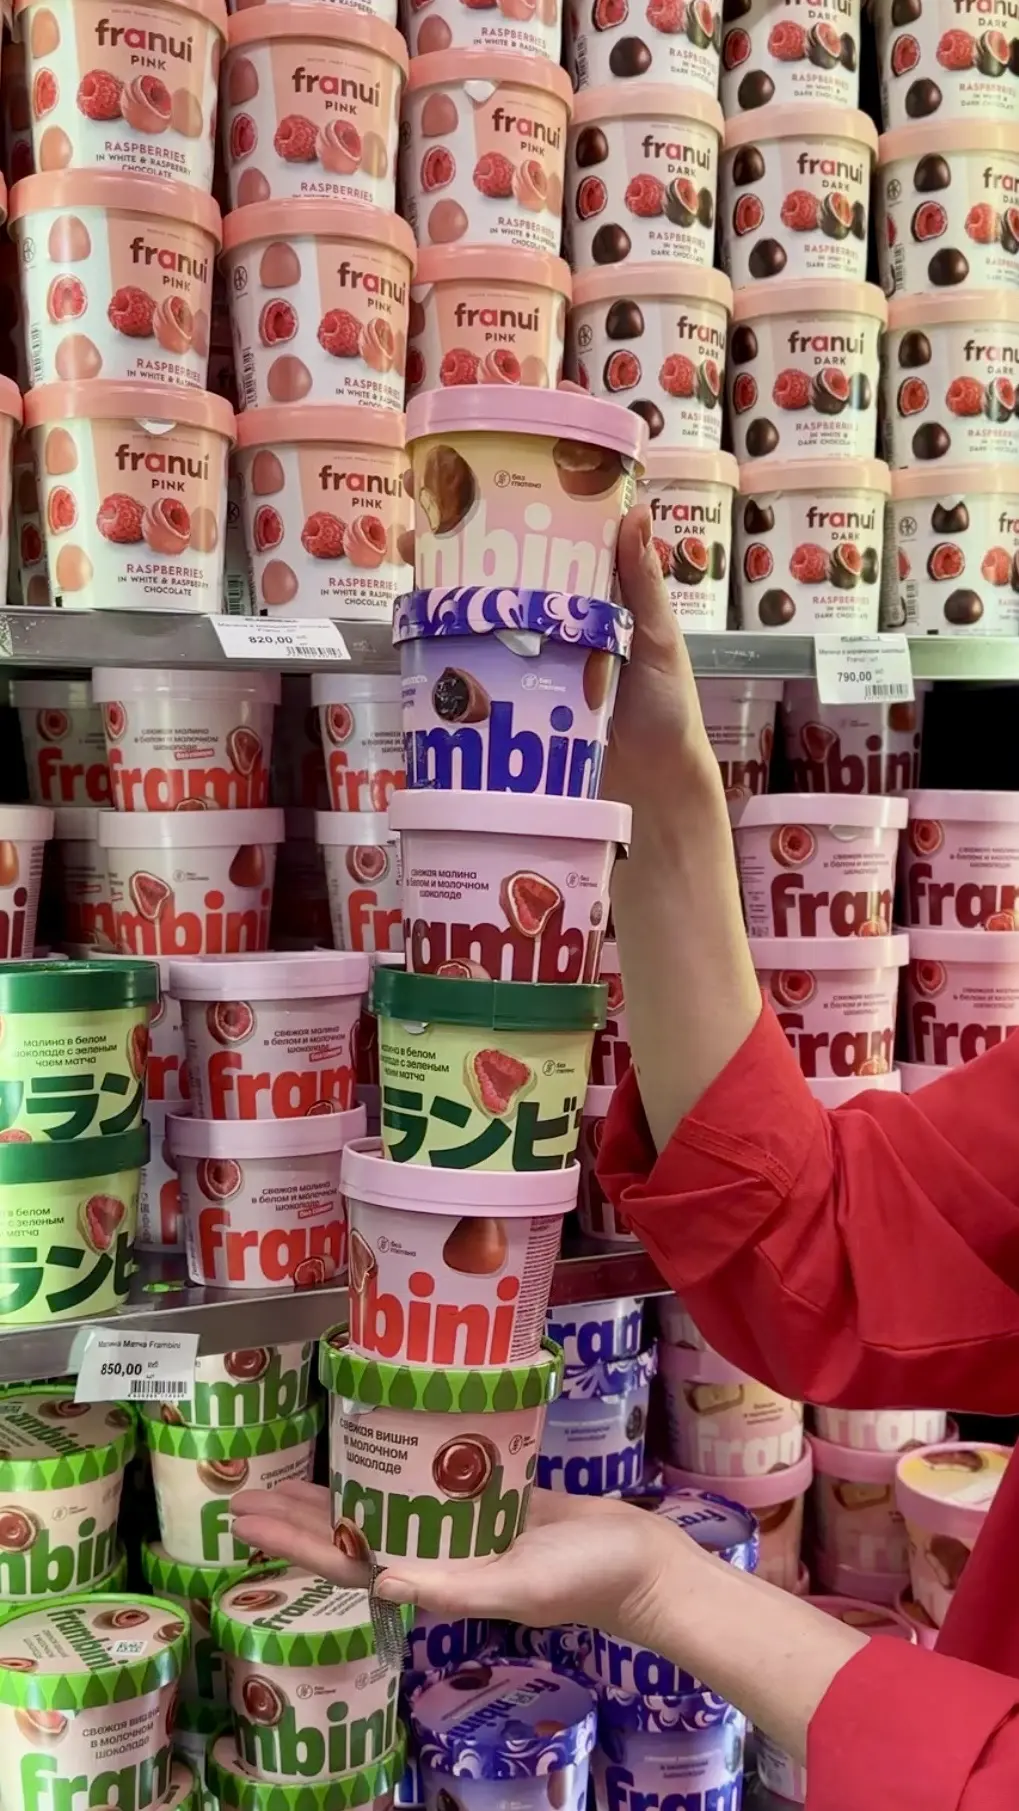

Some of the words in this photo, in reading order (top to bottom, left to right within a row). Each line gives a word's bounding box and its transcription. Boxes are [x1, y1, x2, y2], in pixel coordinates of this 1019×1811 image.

[808, 10, 838, 21] DARK
[978, 17, 1008, 28] DARK
[94, 18, 194, 63] franui
[481, 27, 546, 50] RASPBERRIES
[485, 38, 508, 47] WHITE
[130, 54, 168, 72] PINK
[291, 66, 382, 108] franui
[324, 100, 358, 115] PINK
[491, 107, 561, 150] franui
[105, 141, 187, 164] RASPBERRIES
[520, 140, 546, 157] PINK
[641, 135, 711, 171] franui
[96, 154, 105, 162] IN
[109, 154, 136, 163] WHITE
[150, 158, 192, 176] RASPBERRY
[667, 164, 696, 177] DARK
[797, 152, 863, 184] franui
[301, 182, 374, 202] RASPBERRIES
[821, 179, 851, 192] DARK
[501, 228, 522, 237] WHITE
[130, 237, 208, 285] franui
[162, 275, 191, 292] PINK
[337, 261, 406, 308] franui
[367, 296, 392, 315] PINK
[454, 303, 539, 331] franui
[485, 332, 516, 343] PINK
[788, 331, 865, 355] franui
[813, 356, 847, 366] DARK
[140, 371, 165, 382] WHITE
[347, 389, 370, 399] WHITE
[115, 444, 210, 480] franui
[151, 479, 186, 493] PINK
[319, 465, 403, 499] franui
[351, 497, 384, 511] PINK
[651, 499, 722, 524] franui
[806, 506, 875, 530] franui
[674, 524, 706, 535] DARK
[831, 531, 860, 541] DARK
[126, 563, 204, 579] RASPBERRIES
[131, 576, 158, 585] WHITE
[329, 577, 398, 591] RASPBERRIES
[144, 586, 192, 597] CHOCOLATE
[320, 588, 329, 596] IN
[333, 589, 357, 597] WHITE
[345, 598, 388, 608] CHOCOLATE
[248, 635, 293, 645] 820,00
[837, 671, 872, 684] 790,00
[438, 869, 477, 880] малина
[437, 880, 490, 891] молочном
[419, 890, 462, 901] шоколаде
[274, 1029, 309, 1037] свежая
[24, 1039, 65, 1047] малина
[75, 1035, 107, 1045] белом
[271, 1038, 301, 1046] белом
[75, 1044, 118, 1055] зеленым
[406, 1046, 436, 1060] белом
[36, 1059, 62, 1067] чаем
[65, 1056, 96, 1066] матча
[406, 1060, 450, 1073] зеленым
[400, 1071, 425, 1082] матча
[262, 1187, 298, 1195] свежая
[299, 1181, 331, 1191] малина
[259, 1195, 289, 1204] белом
[16, 1208, 51, 1216] белом
[17, 1217, 64, 1227] зеленым
[350, 1271, 519, 1366] bini
[123, 1340, 147, 1348] Матча
[149, 1341, 181, 1349] Frambini
[101, 1362, 142, 1377] 850,00
[340, 1418, 373, 1439] свежая
[376, 1430, 419, 1447] вишня
[344, 1435, 349, 1445] в
[350, 1437, 408, 1461] молочном
[347, 1450, 402, 1476] шоколаде
[47, 1608, 129, 1672] frambini
[83, 1721, 127, 1737] свежая
[91, 1740, 98, 1748] в
[100, 1722, 154, 1747] молочном
[95, 1736, 150, 1760] шоколаде
